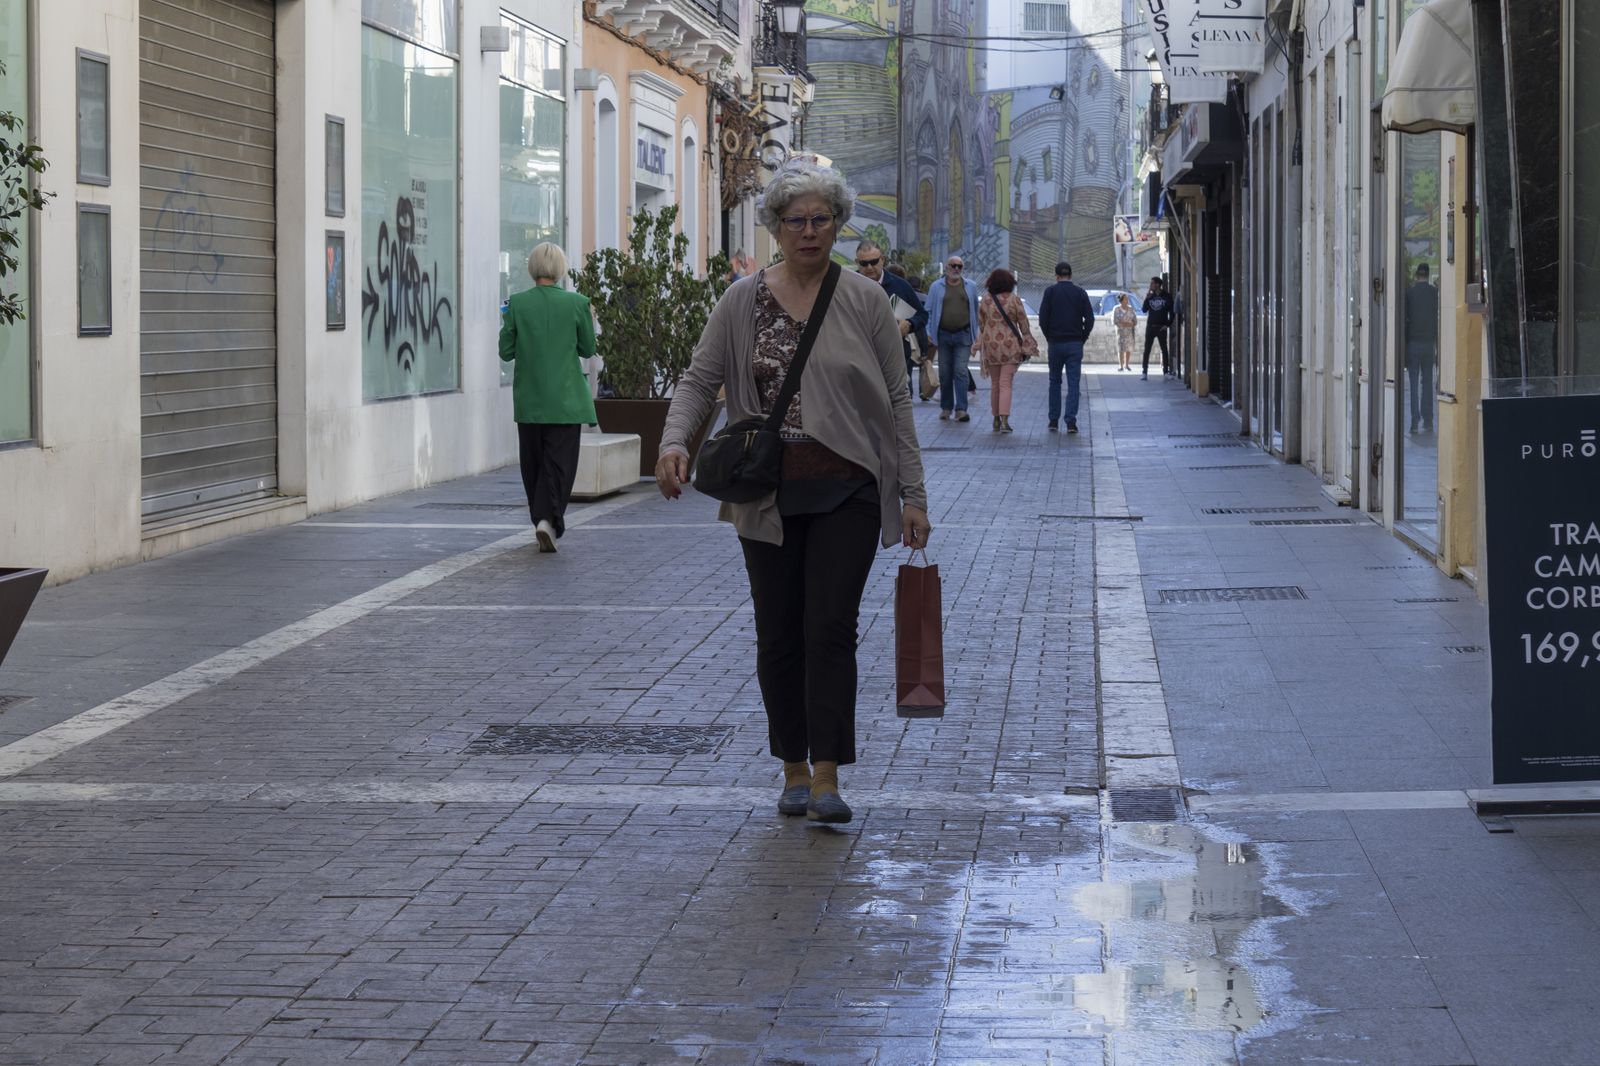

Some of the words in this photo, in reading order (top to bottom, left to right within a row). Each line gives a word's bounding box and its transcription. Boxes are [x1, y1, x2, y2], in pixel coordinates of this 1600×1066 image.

[1549, 521, 1600, 546] TRA
[1534, 553, 1600, 578] CAM
[1526, 585, 1600, 610] CORB
